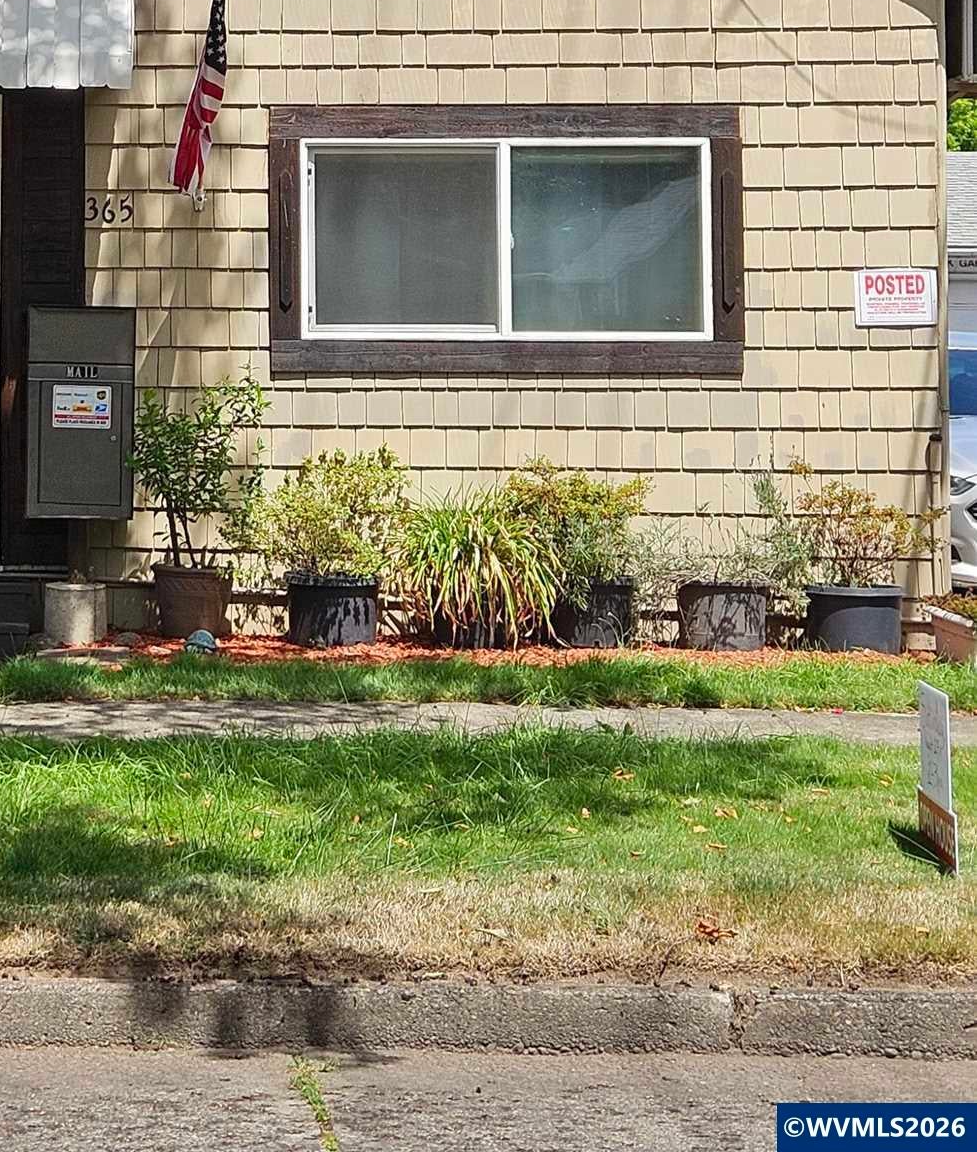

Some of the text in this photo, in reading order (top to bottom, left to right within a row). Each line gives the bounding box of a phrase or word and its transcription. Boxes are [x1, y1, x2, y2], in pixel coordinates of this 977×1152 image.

[85, 193, 134, 223] 365
[958, 259, 977, 267] GA
[864, 274, 926, 295] POSTED
[66, 366, 98, 378] MAIL
